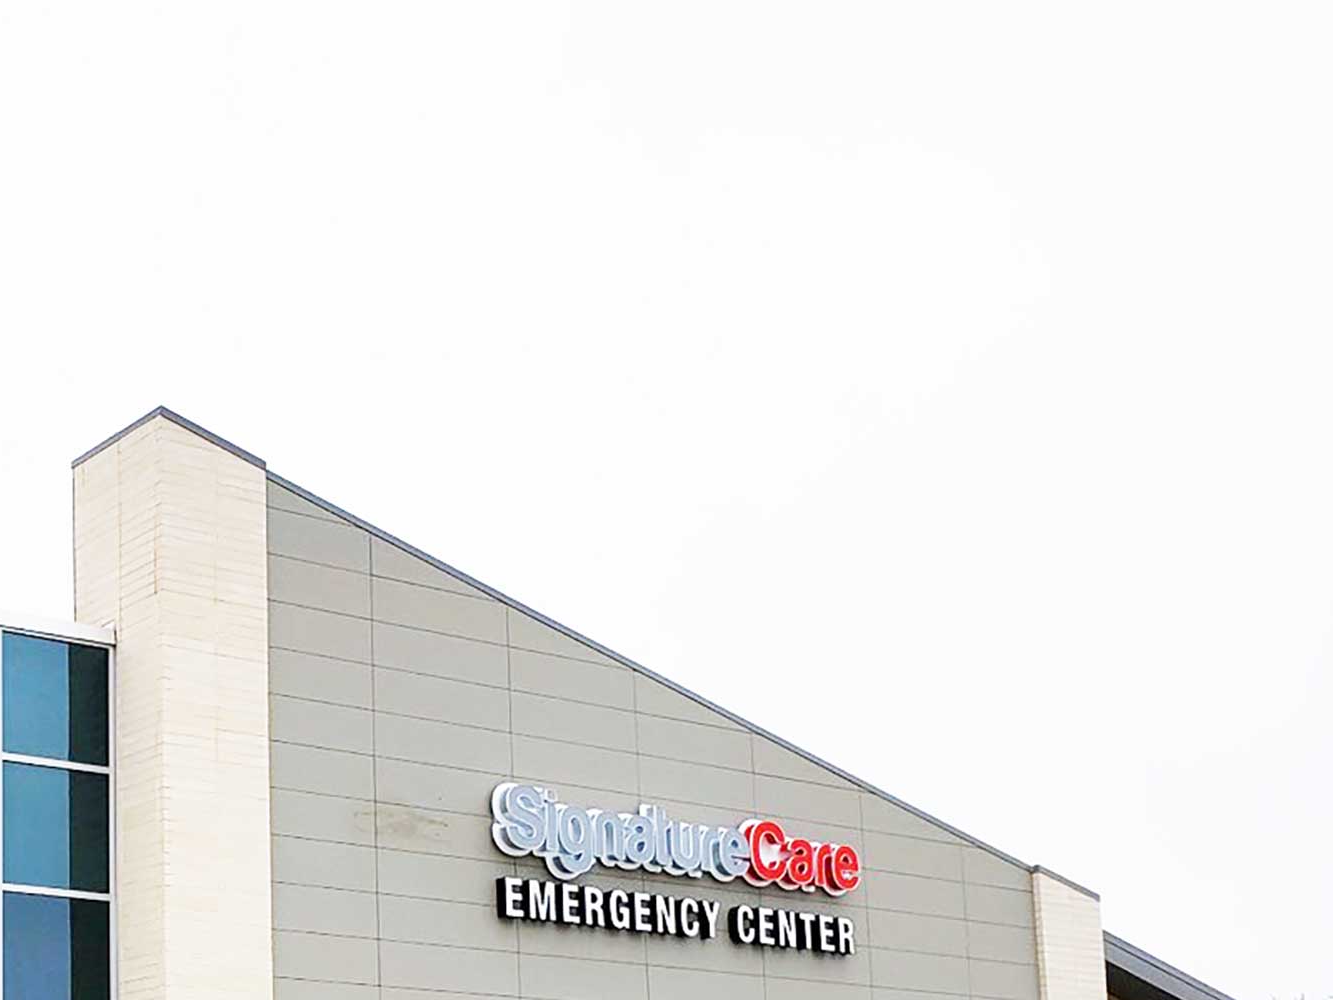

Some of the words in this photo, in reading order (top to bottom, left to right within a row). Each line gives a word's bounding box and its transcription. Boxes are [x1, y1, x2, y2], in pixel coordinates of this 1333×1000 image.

[493, 782, 862, 894] SignatureCare
[497, 876, 722, 940] EMERGENCY
[730, 903, 857, 956] CENTER
